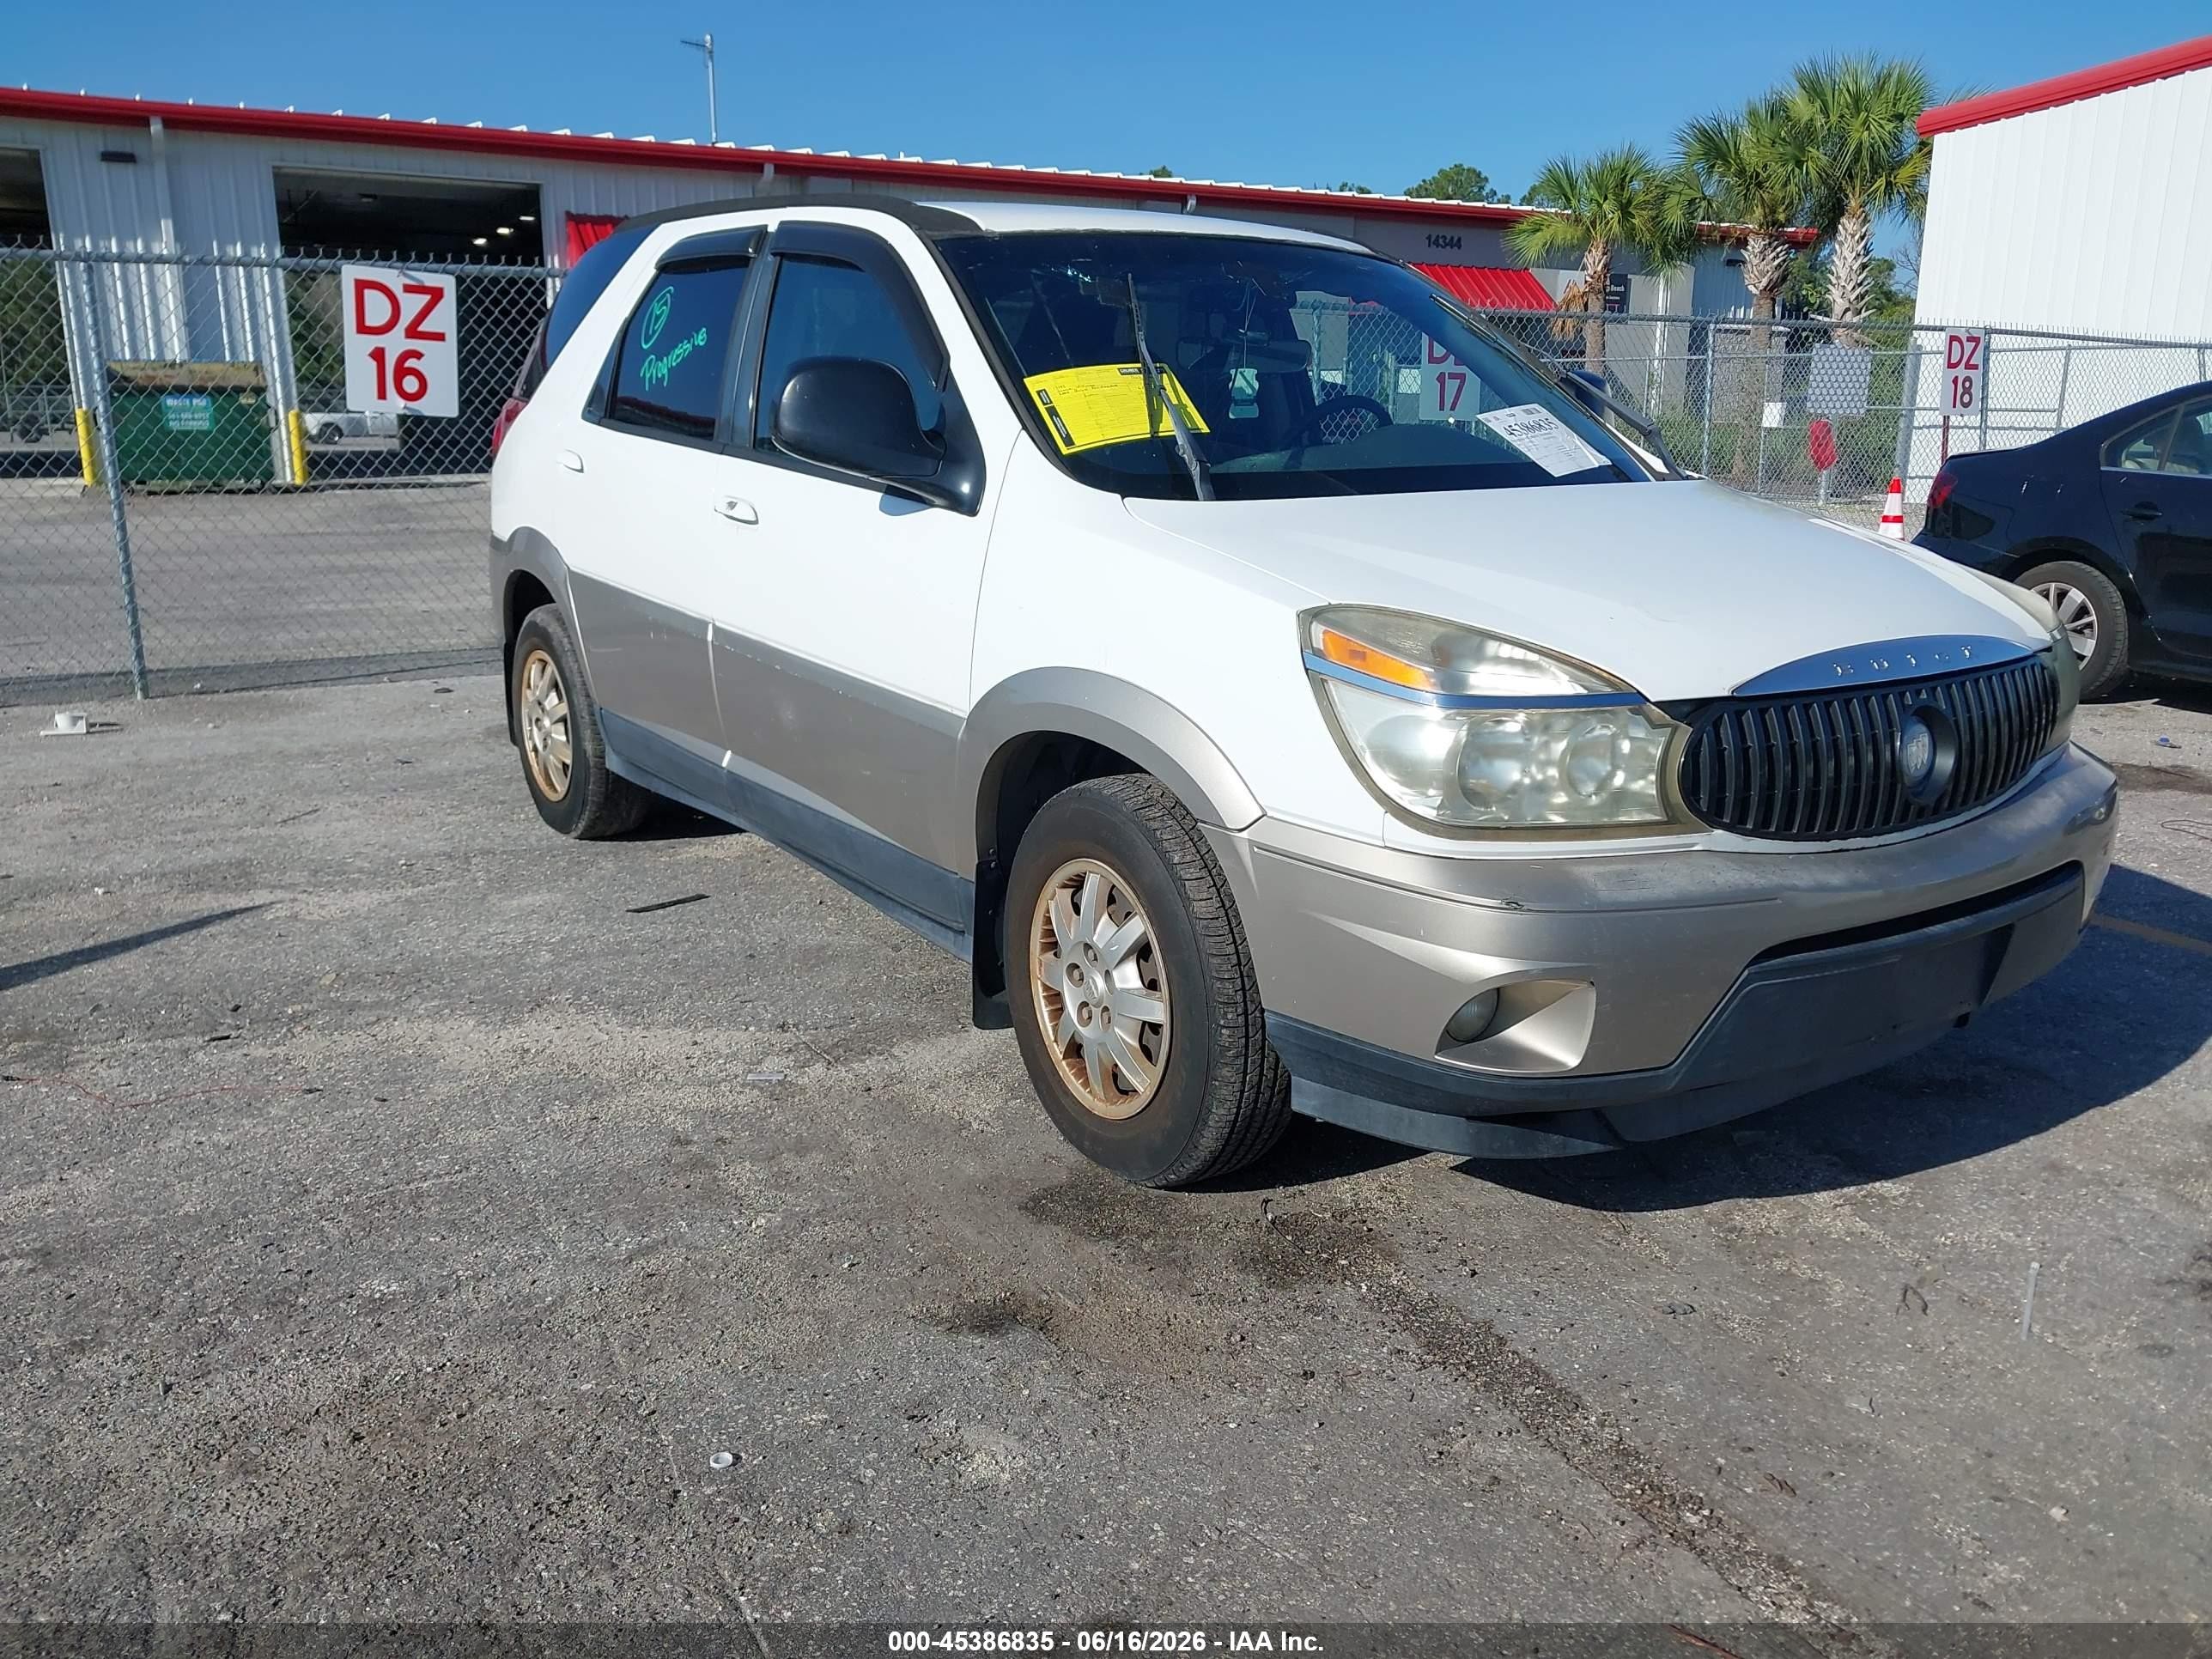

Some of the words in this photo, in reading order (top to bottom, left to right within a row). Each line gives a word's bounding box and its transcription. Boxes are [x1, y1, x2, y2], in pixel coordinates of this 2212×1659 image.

[1425, 234, 1462, 250] 14344
[354, 278, 446, 342] DZ
[1947, 335, 1981, 370] DZ
[368, 346, 428, 402] 16
[1436, 371, 1466, 411] 17
[1952, 375, 1972, 409] 18
[1504, 417, 1559, 437] 45386835
